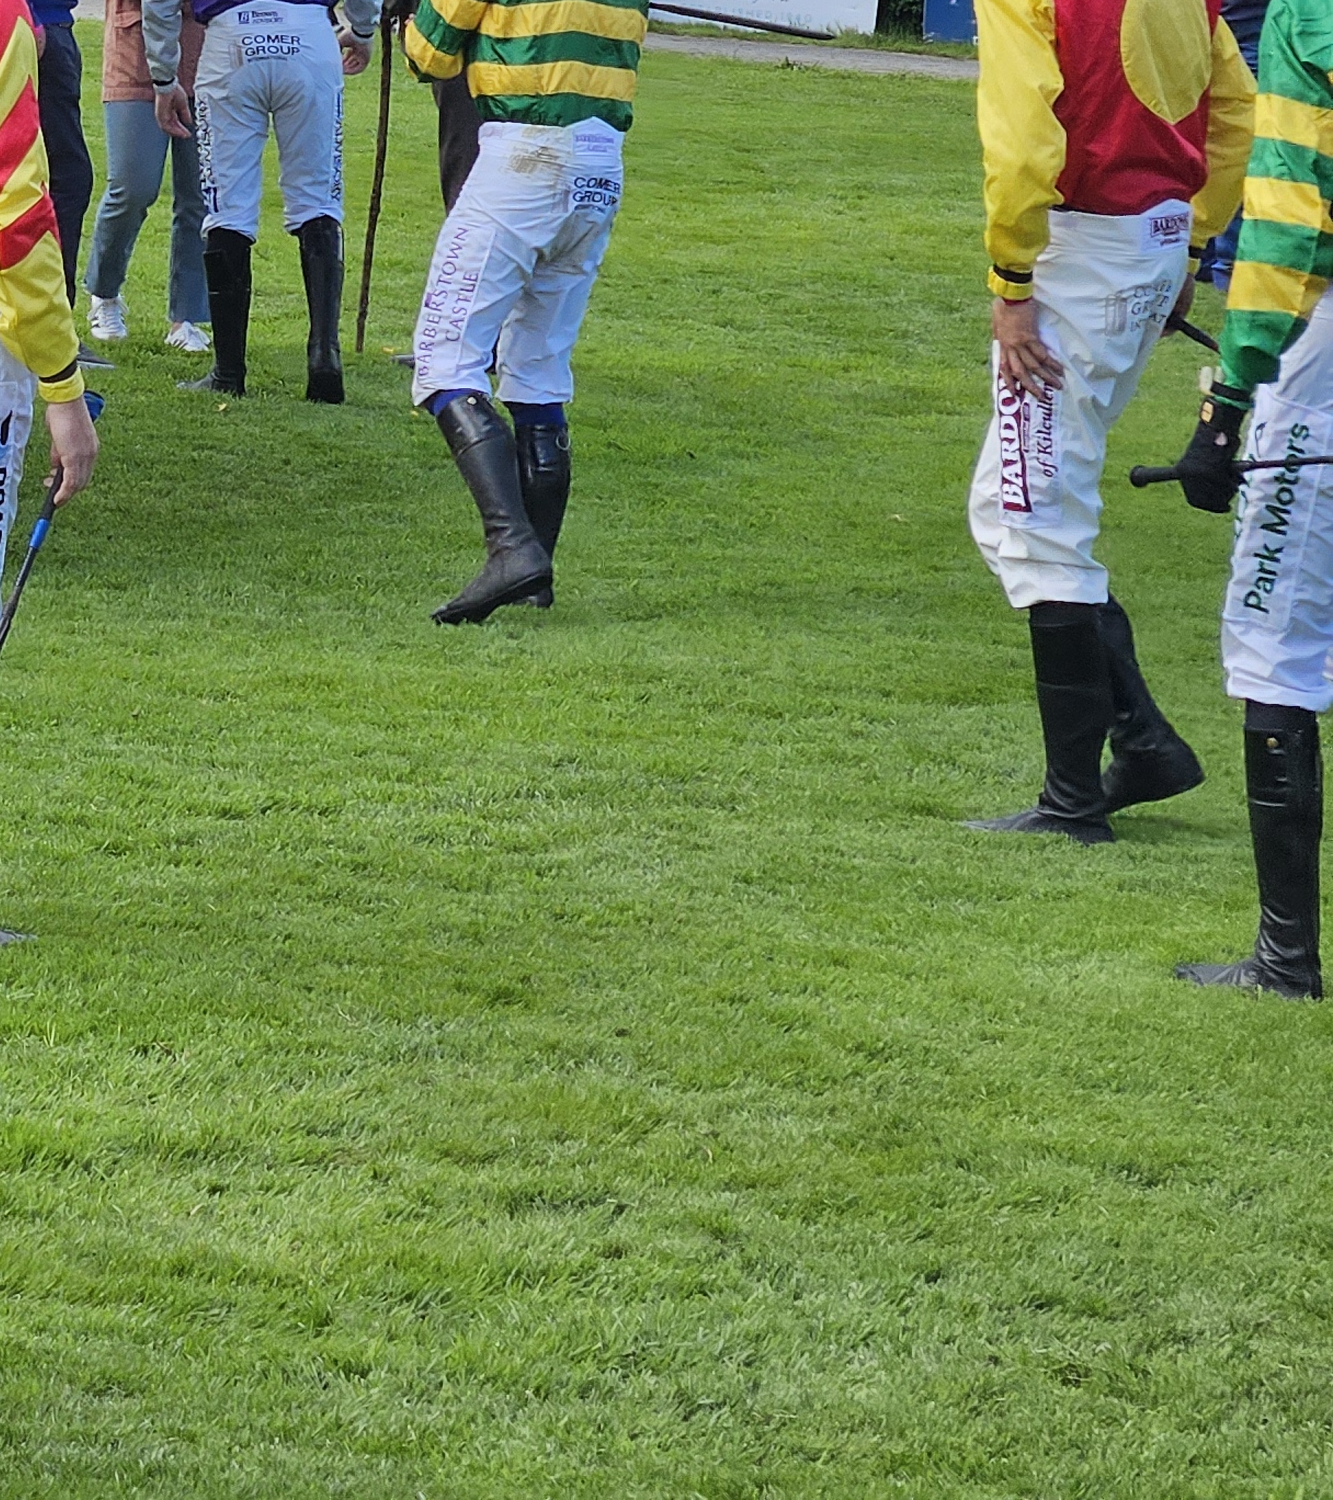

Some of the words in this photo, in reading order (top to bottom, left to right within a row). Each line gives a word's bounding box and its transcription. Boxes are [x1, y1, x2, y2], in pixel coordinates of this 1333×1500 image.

[242, 34, 301, 46] COMER
[245, 45, 301, 57] GROUP
[573, 177, 621, 194] COMER
[572, 190, 618, 206] GROUP
[416, 226, 470, 377] BARBERSTOWN
[445, 270, 480, 342] CASTLE
[1037, 457, 1059, 478] of
[1243, 543, 1285, 615] Park
